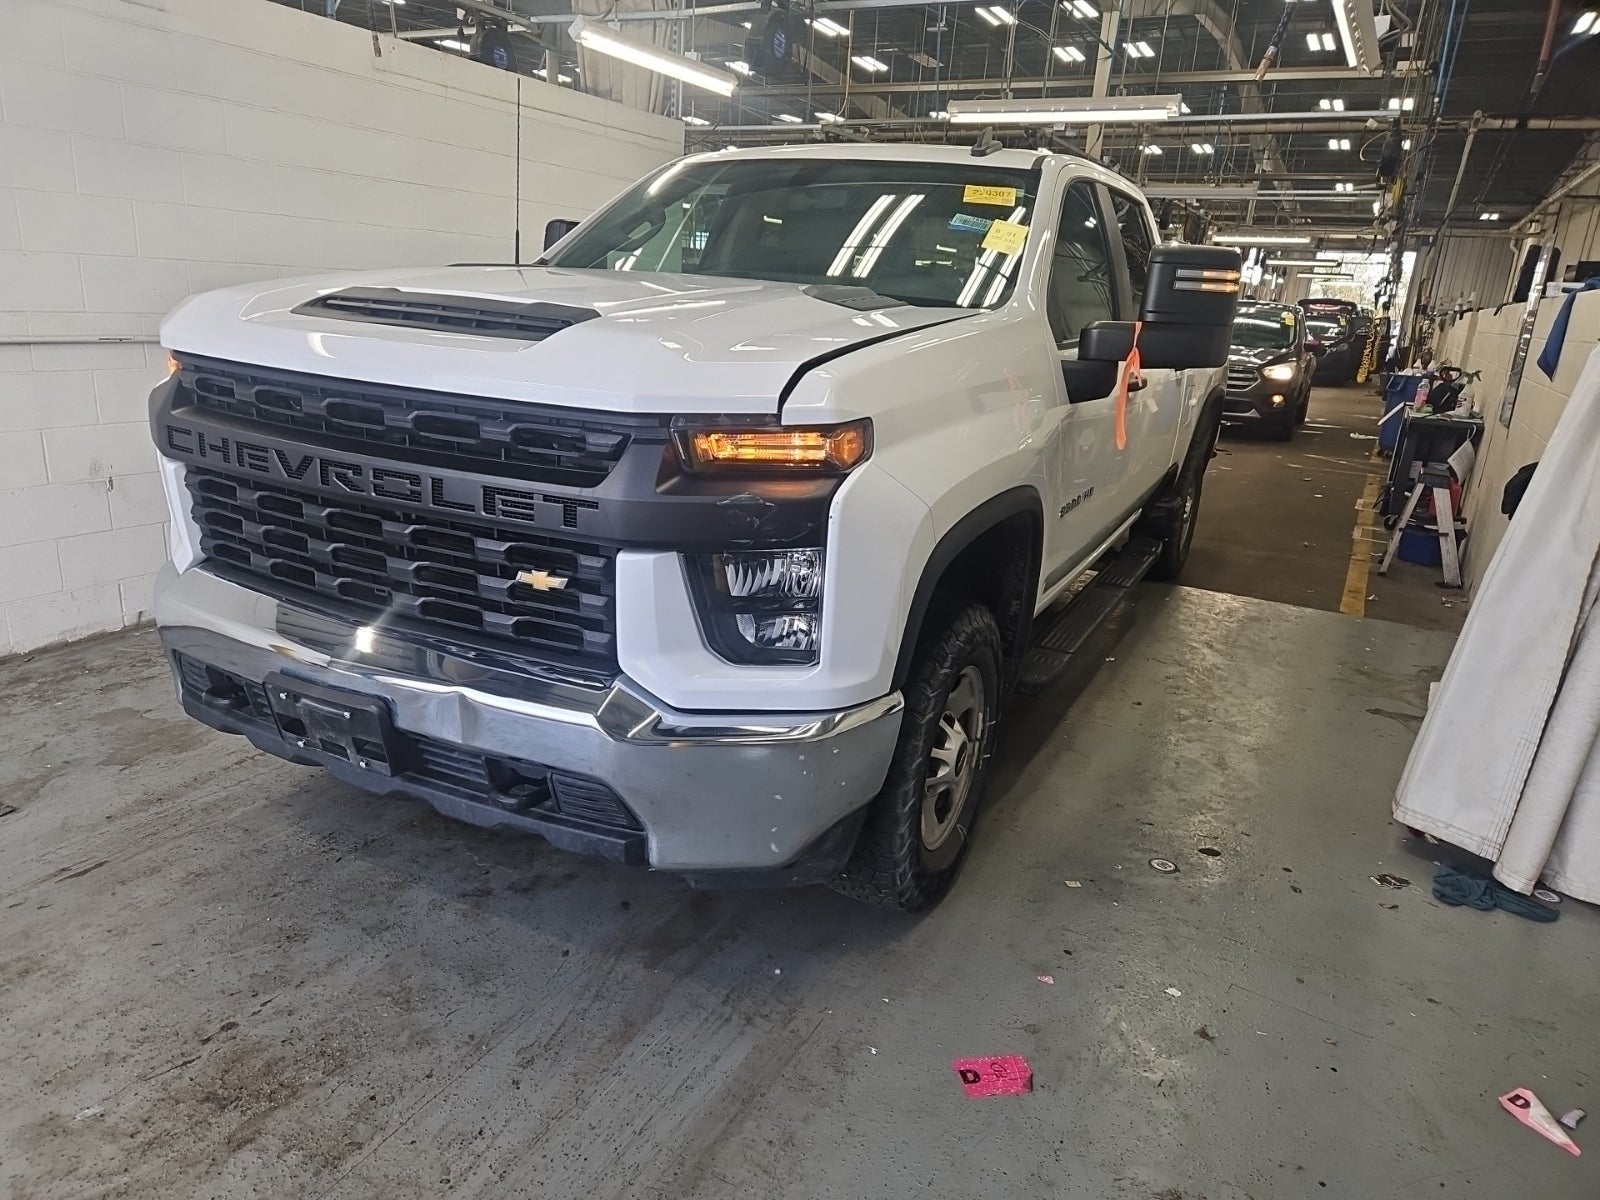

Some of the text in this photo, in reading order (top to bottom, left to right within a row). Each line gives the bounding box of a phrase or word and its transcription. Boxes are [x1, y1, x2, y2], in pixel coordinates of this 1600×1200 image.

[166, 425, 600, 530] CHEVROLET
[958, 1069, 981, 1084] D
[1506, 1093, 1531, 1109] D
